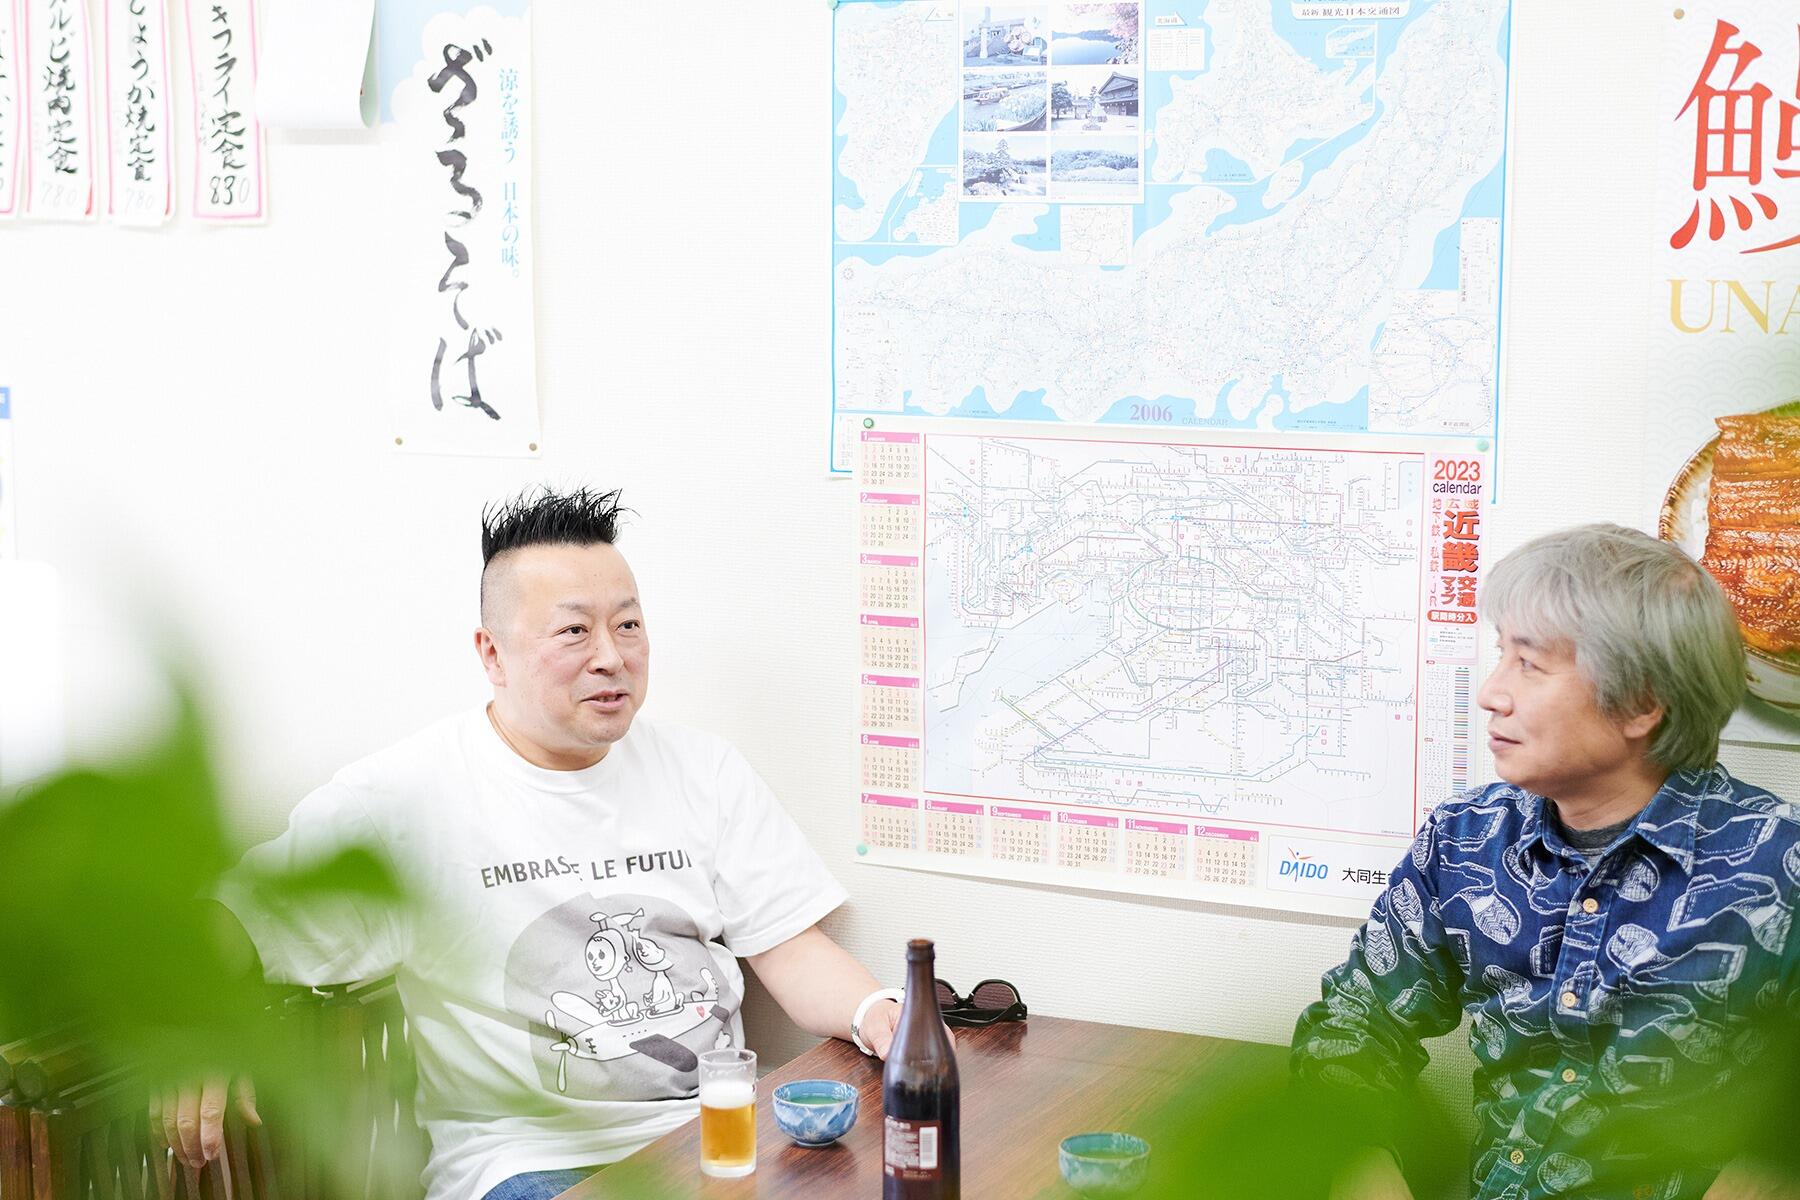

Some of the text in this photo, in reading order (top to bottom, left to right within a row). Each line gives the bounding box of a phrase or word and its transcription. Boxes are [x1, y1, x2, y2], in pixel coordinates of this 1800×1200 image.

[211, 4, 247, 170] キフライ定食
[210, 175, 250, 205] 830
[1130, 402, 1228, 426] 2006 CALENDAR
[1434, 460, 1481, 482] 2023
[1433, 482, 1482, 495] calendar
[1443, 510, 1480, 573] 近畿
[1440, 576, 1457, 605] マップ
[1456, 576, 1477, 608] 交通
[591, 860, 617, 880] LE
[1279, 860, 1329, 883] DAIDO
[1342, 868, 1392, 885] 大同生
